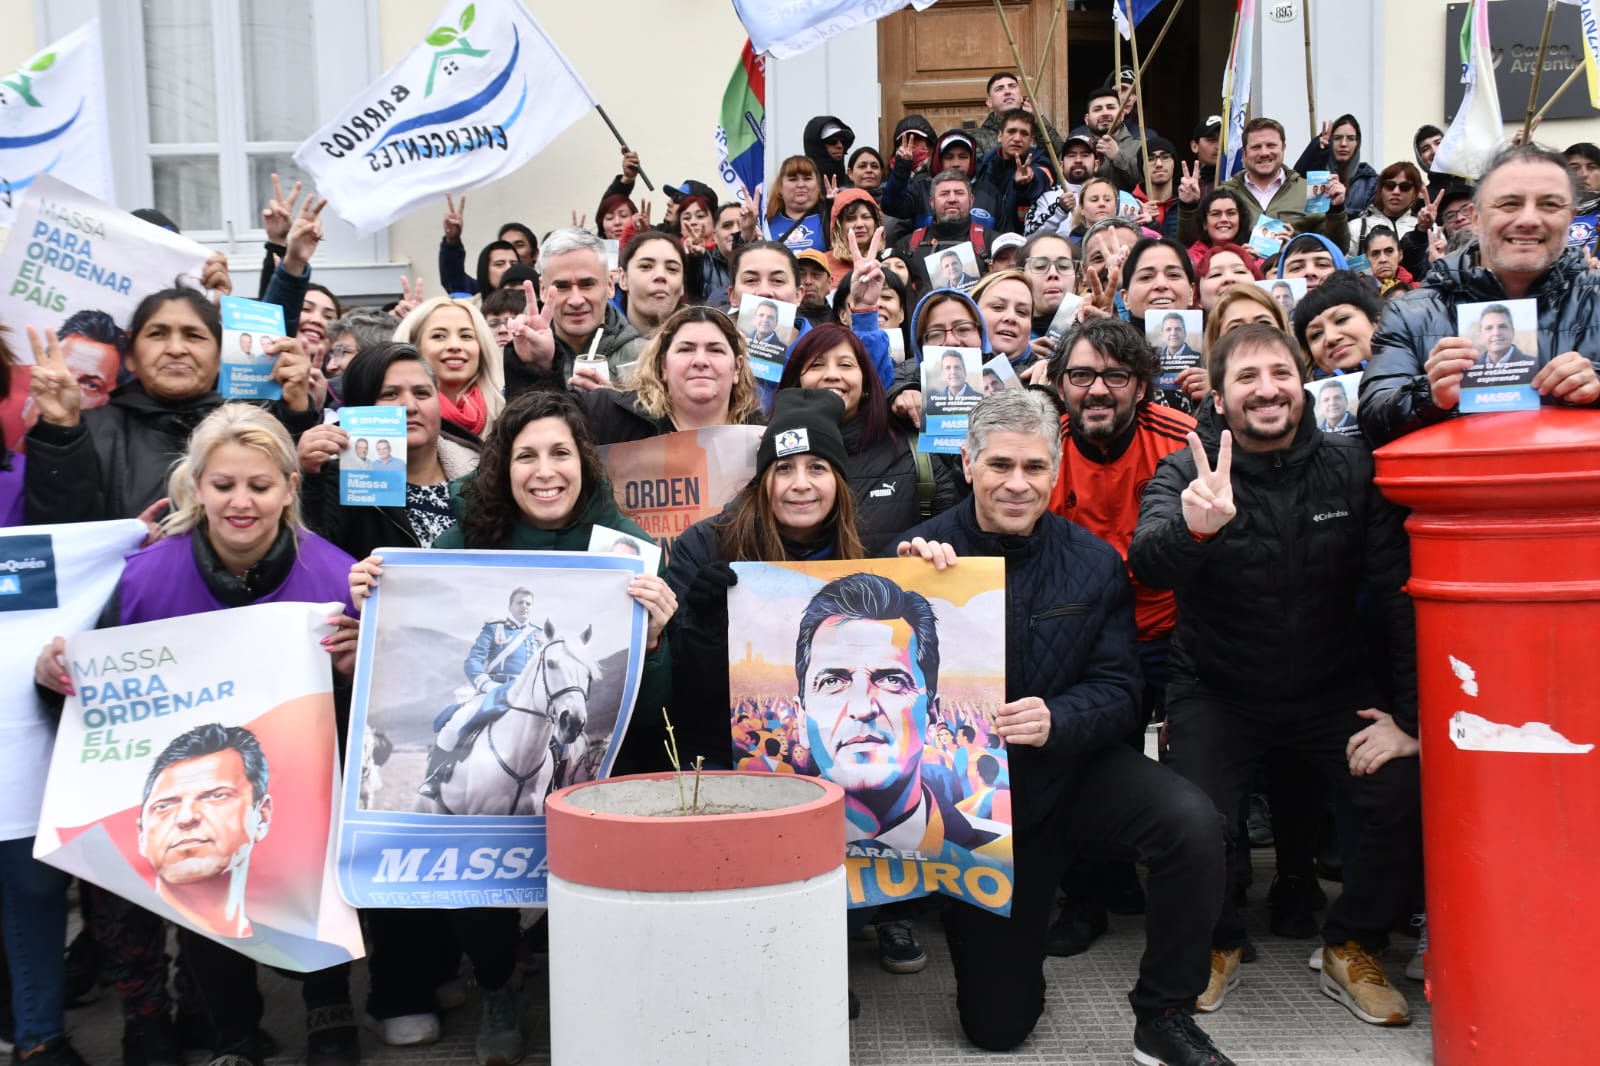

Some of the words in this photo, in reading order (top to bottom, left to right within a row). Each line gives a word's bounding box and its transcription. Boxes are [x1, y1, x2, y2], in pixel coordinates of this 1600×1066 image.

[1276, 5, 1292, 18] 893
[33, 220, 92, 260] PARA
[18, 260, 45, 285] EL
[27, 241, 132, 296] ORDENAR
[1495, 360, 1535, 369] Argentina
[941, 420, 969, 429] MASS
[347, 479, 388, 489] Massa
[625, 477, 700, 509] ORDEN
[347, 494, 376, 503] Rossi
[72, 645, 179, 679] MASSA
[80, 674, 168, 707] PARA
[83, 680, 235, 729] ORDENAR
[83, 729, 120, 748] EL
[901, 850, 929, 861] EL
[845, 857, 1013, 908] TURO
[368, 887, 548, 905] PRESIDENT
